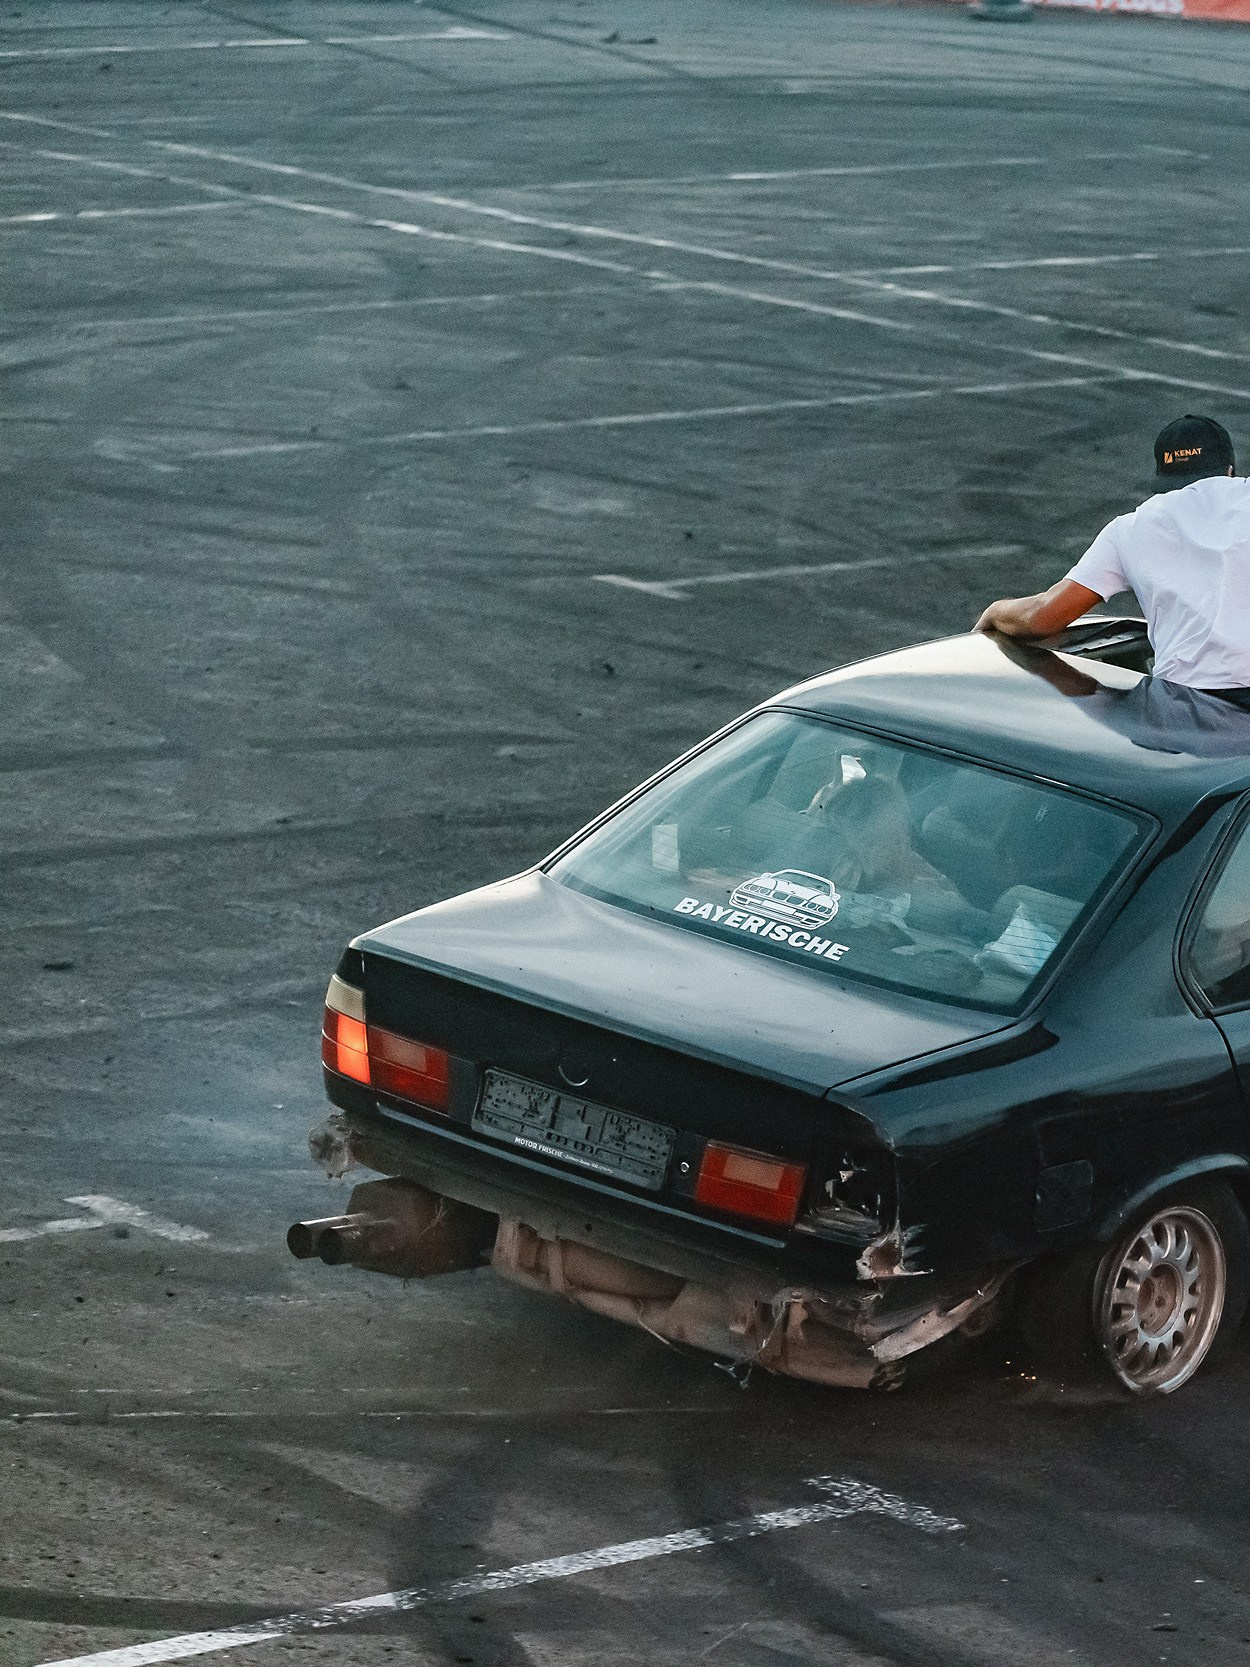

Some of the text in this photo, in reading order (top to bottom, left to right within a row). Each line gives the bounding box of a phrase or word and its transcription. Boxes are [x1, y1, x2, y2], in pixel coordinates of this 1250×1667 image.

[1174, 447, 1202, 457] KENAT
[673, 897, 850, 961] BAYERISCHE
[514, 1136, 564, 1158] MOTOR FRISCHE
